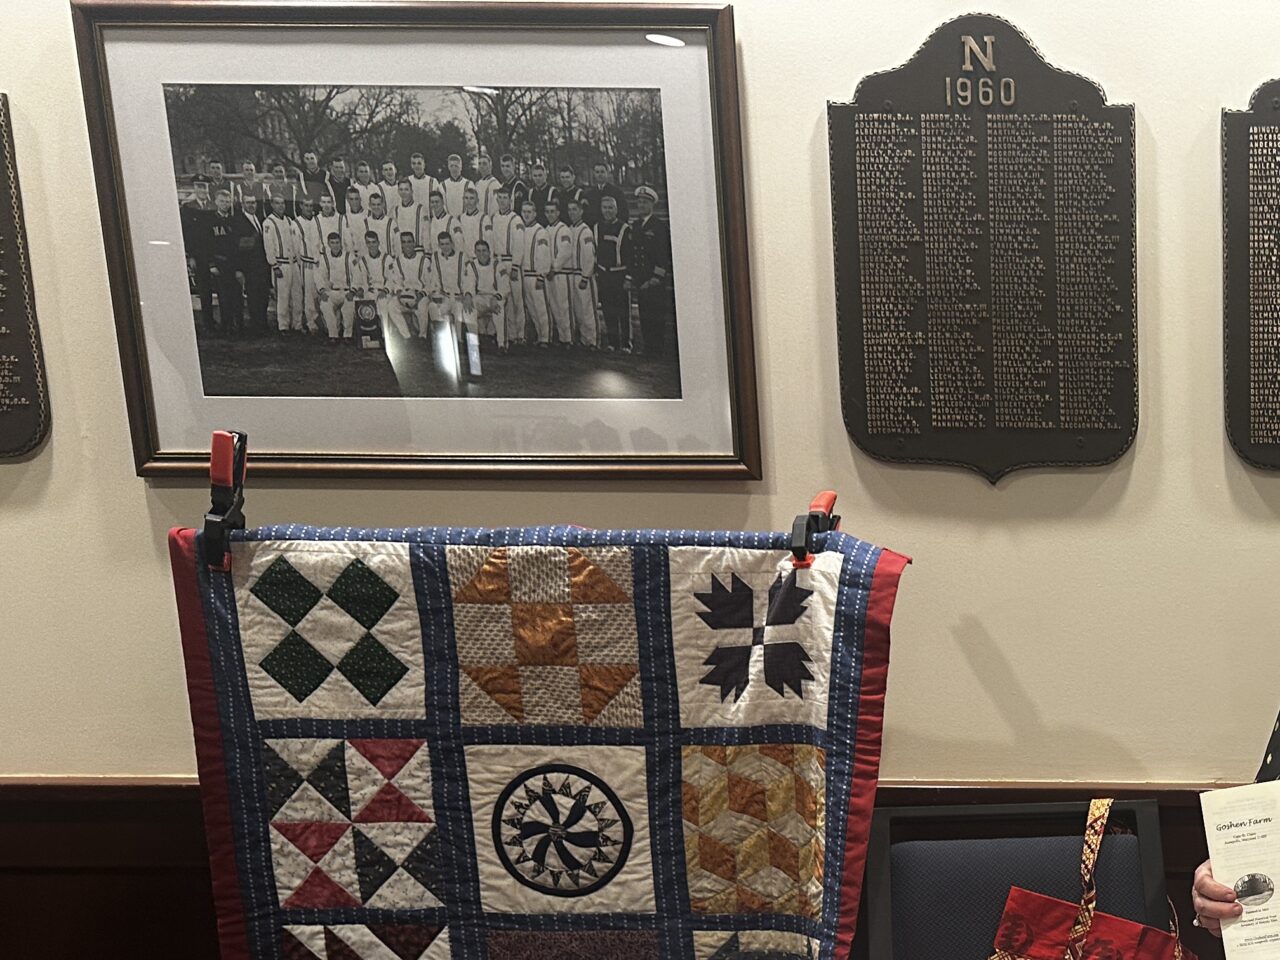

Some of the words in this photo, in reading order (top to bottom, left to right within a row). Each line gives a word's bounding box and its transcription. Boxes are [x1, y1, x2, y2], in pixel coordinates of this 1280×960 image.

[960, 35, 996, 72] N
[945, 77, 1016, 107] 1960
[1216, 821, 1247, 832] Goshen
[1248, 816, 1273, 827] Farm
